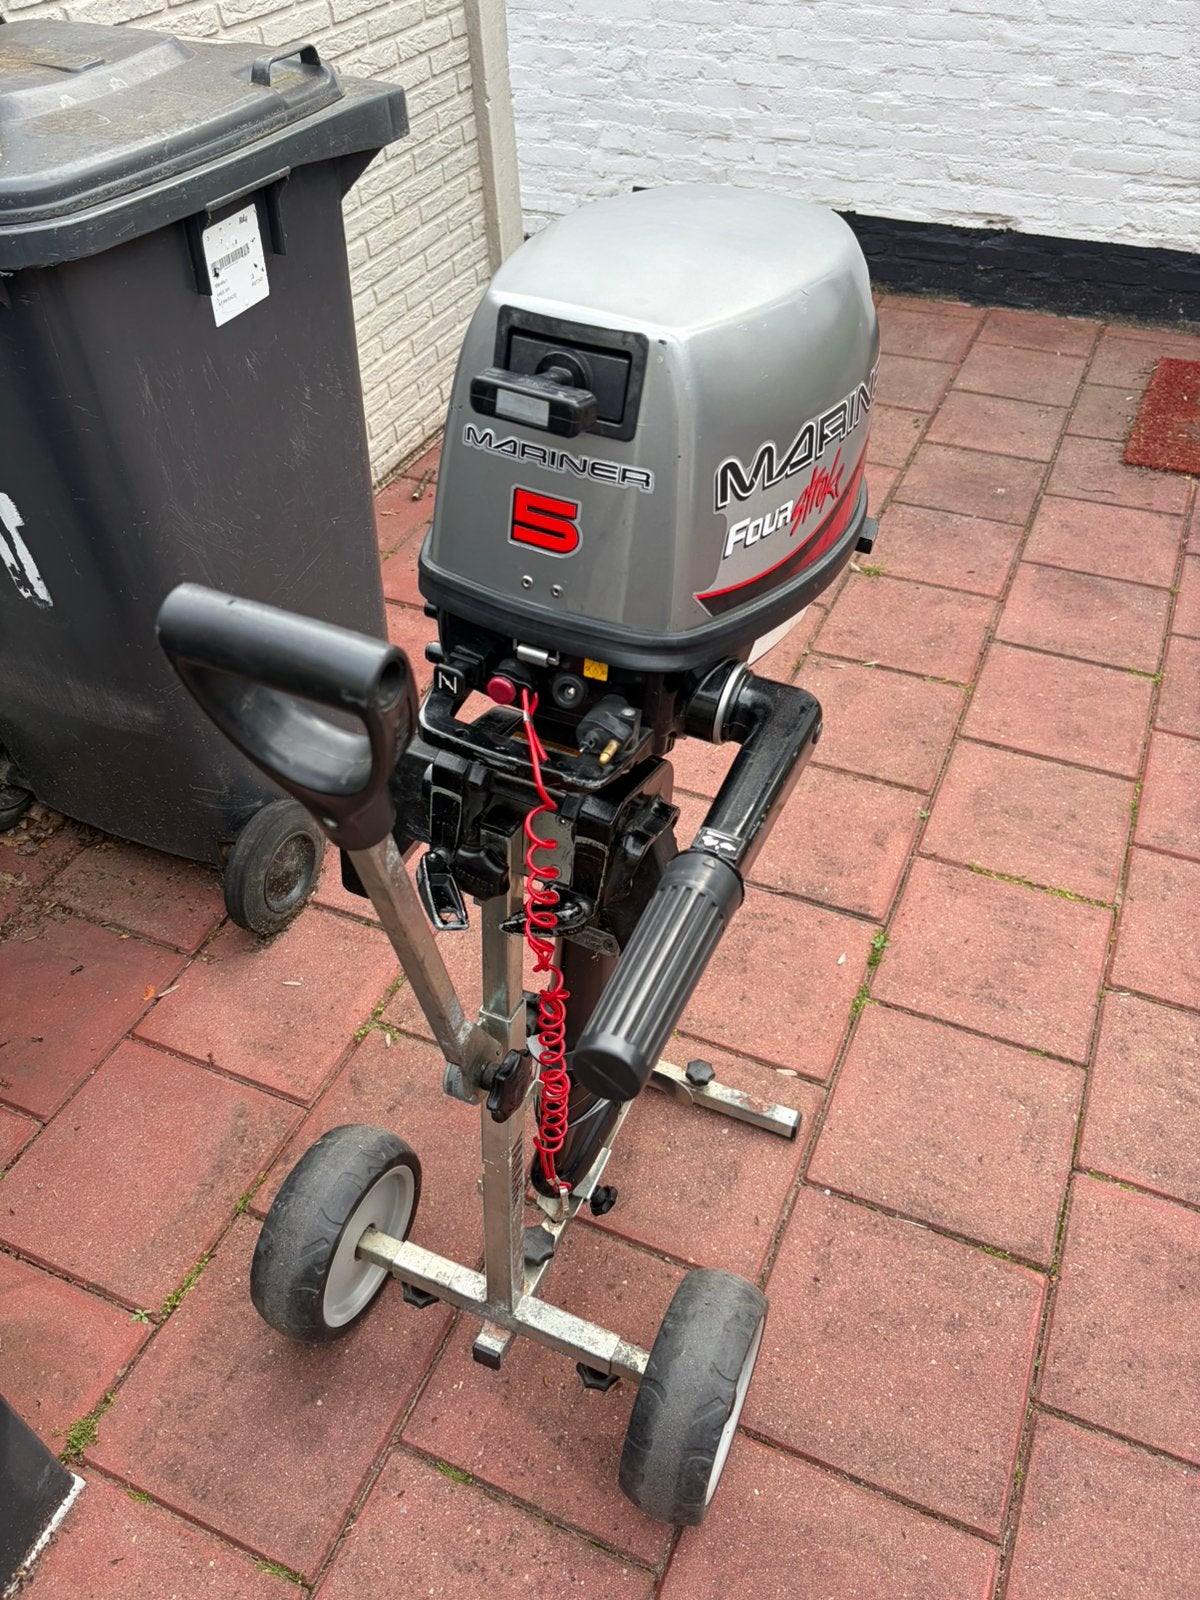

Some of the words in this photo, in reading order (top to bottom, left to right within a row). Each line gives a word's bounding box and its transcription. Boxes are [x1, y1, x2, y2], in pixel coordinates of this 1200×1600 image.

[463, 424, 654, 494] MARINER
[714, 367, 880, 512] MARIN
[509, 487, 582, 555] 5
[723, 500, 795, 560] FOUR
[438, 671, 457, 694] N
